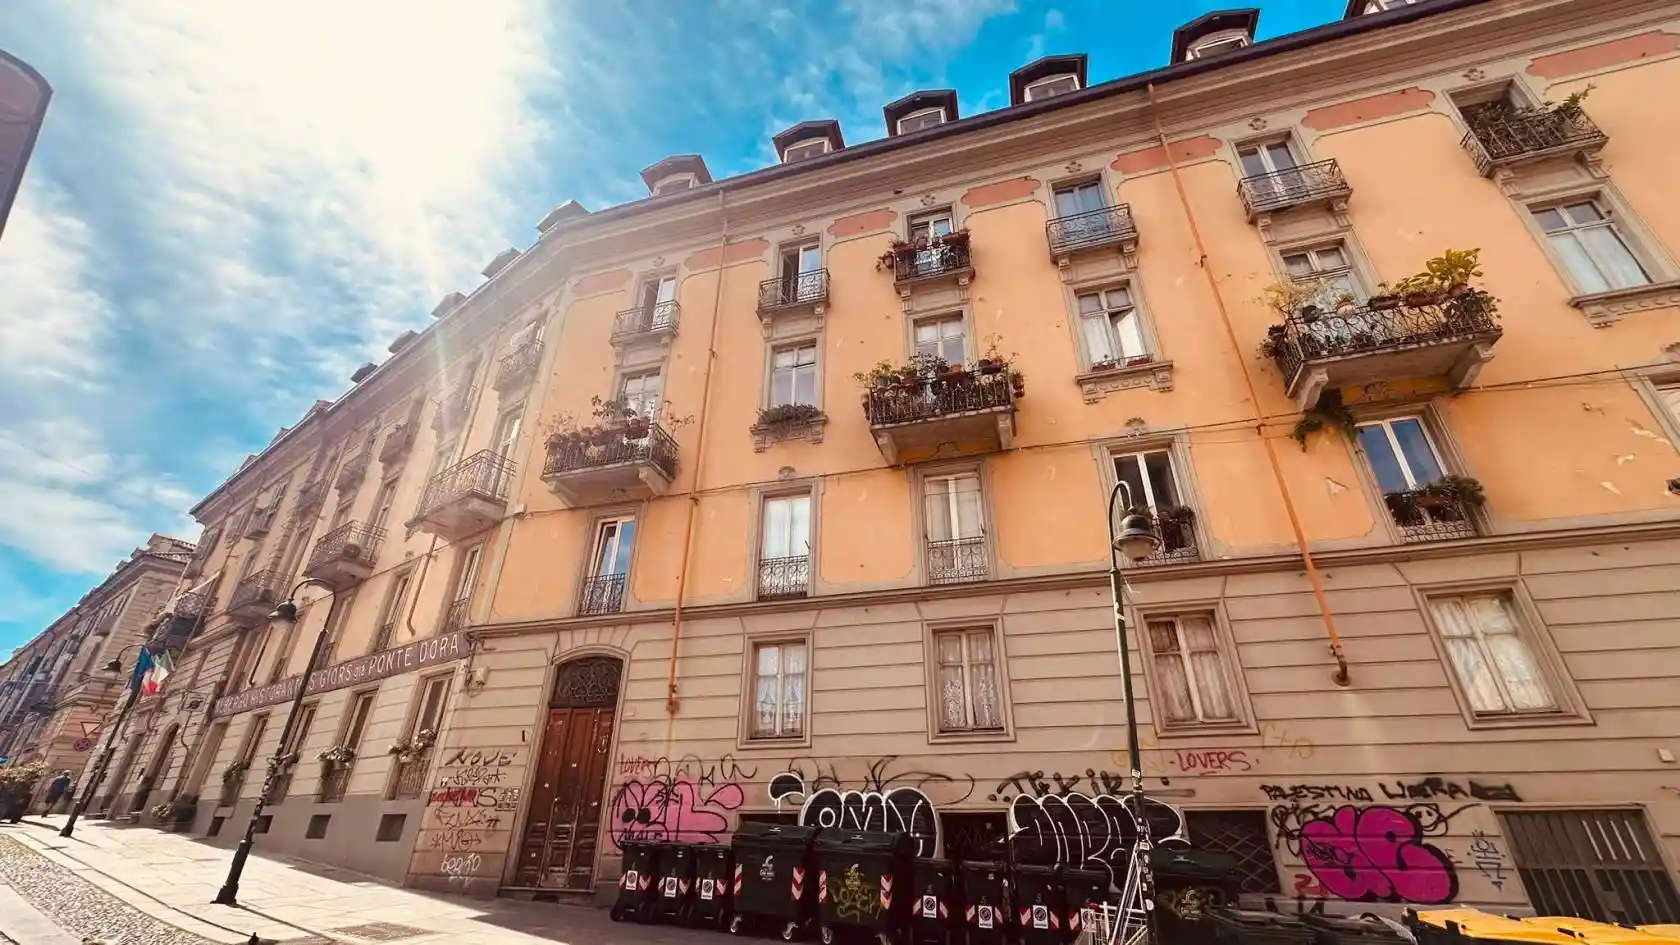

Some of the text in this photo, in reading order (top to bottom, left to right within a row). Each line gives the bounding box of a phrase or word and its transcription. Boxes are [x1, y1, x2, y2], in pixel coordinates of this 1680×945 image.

[319, 663, 352, 689] GIORS
[368, 646, 414, 674] PONTE
[419, 634, 459, 663] DORA
[1175, 749, 1252, 773] LOVERS
